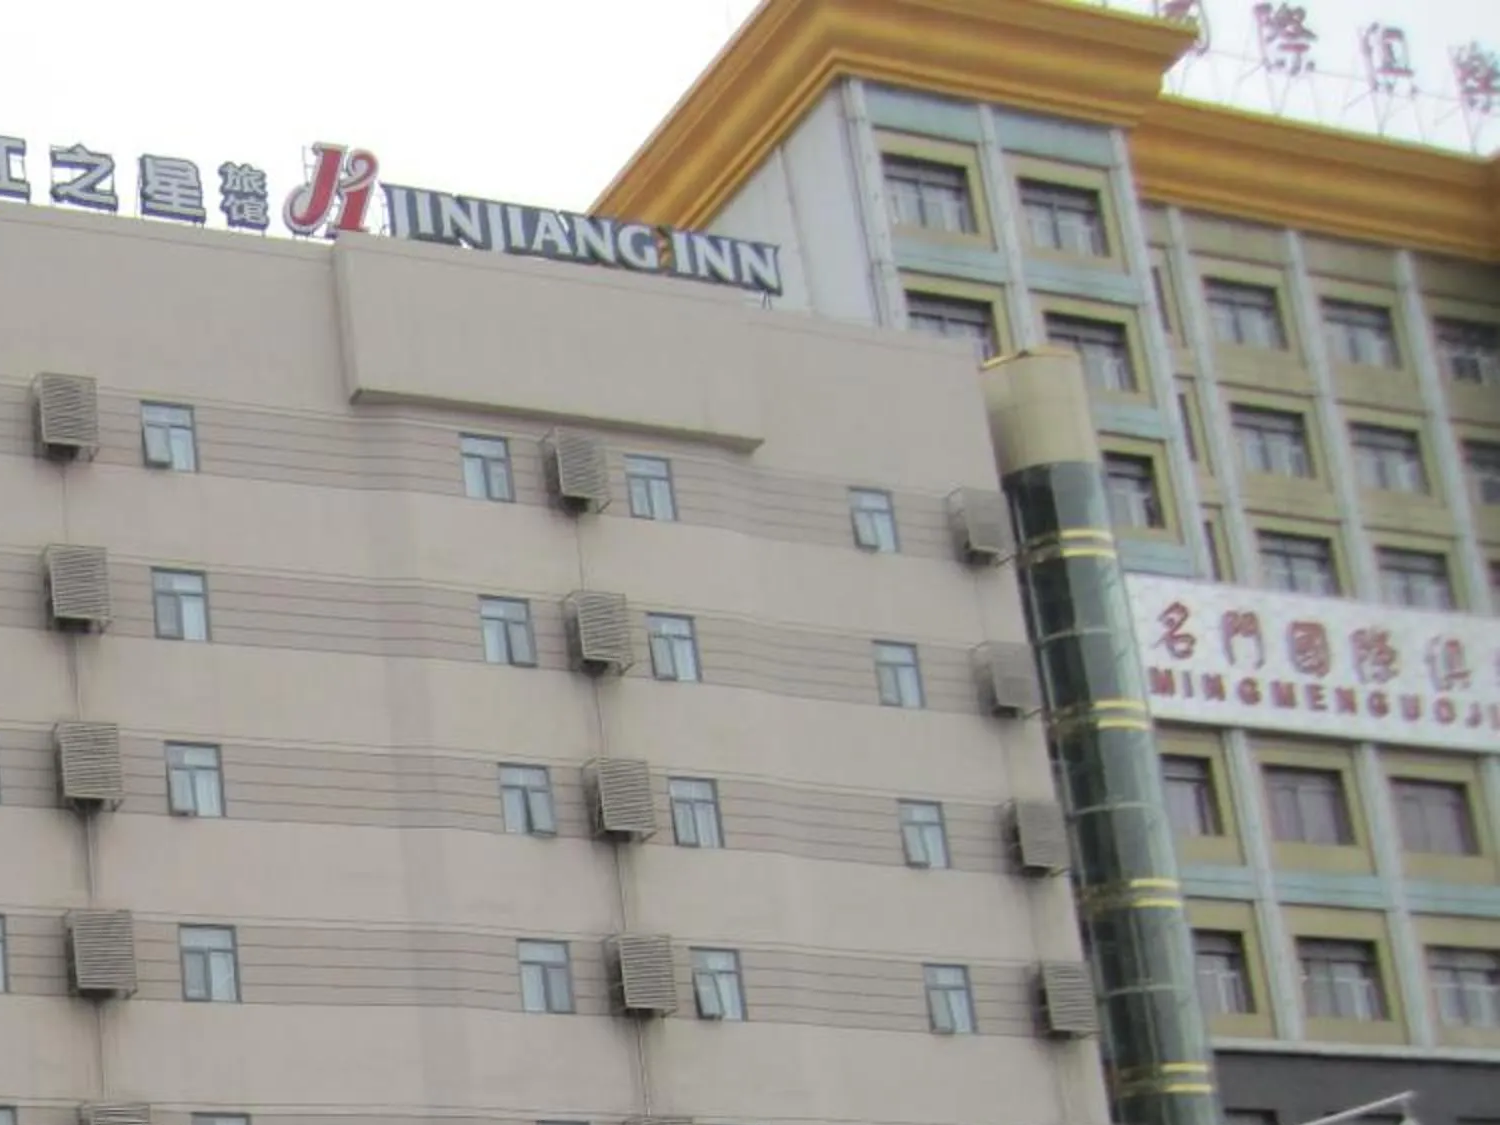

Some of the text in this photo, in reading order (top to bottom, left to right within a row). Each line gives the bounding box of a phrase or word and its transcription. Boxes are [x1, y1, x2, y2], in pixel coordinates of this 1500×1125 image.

[219, 161, 270, 230] 旅馆
[386, 183, 781, 295] JINJIANG INN
